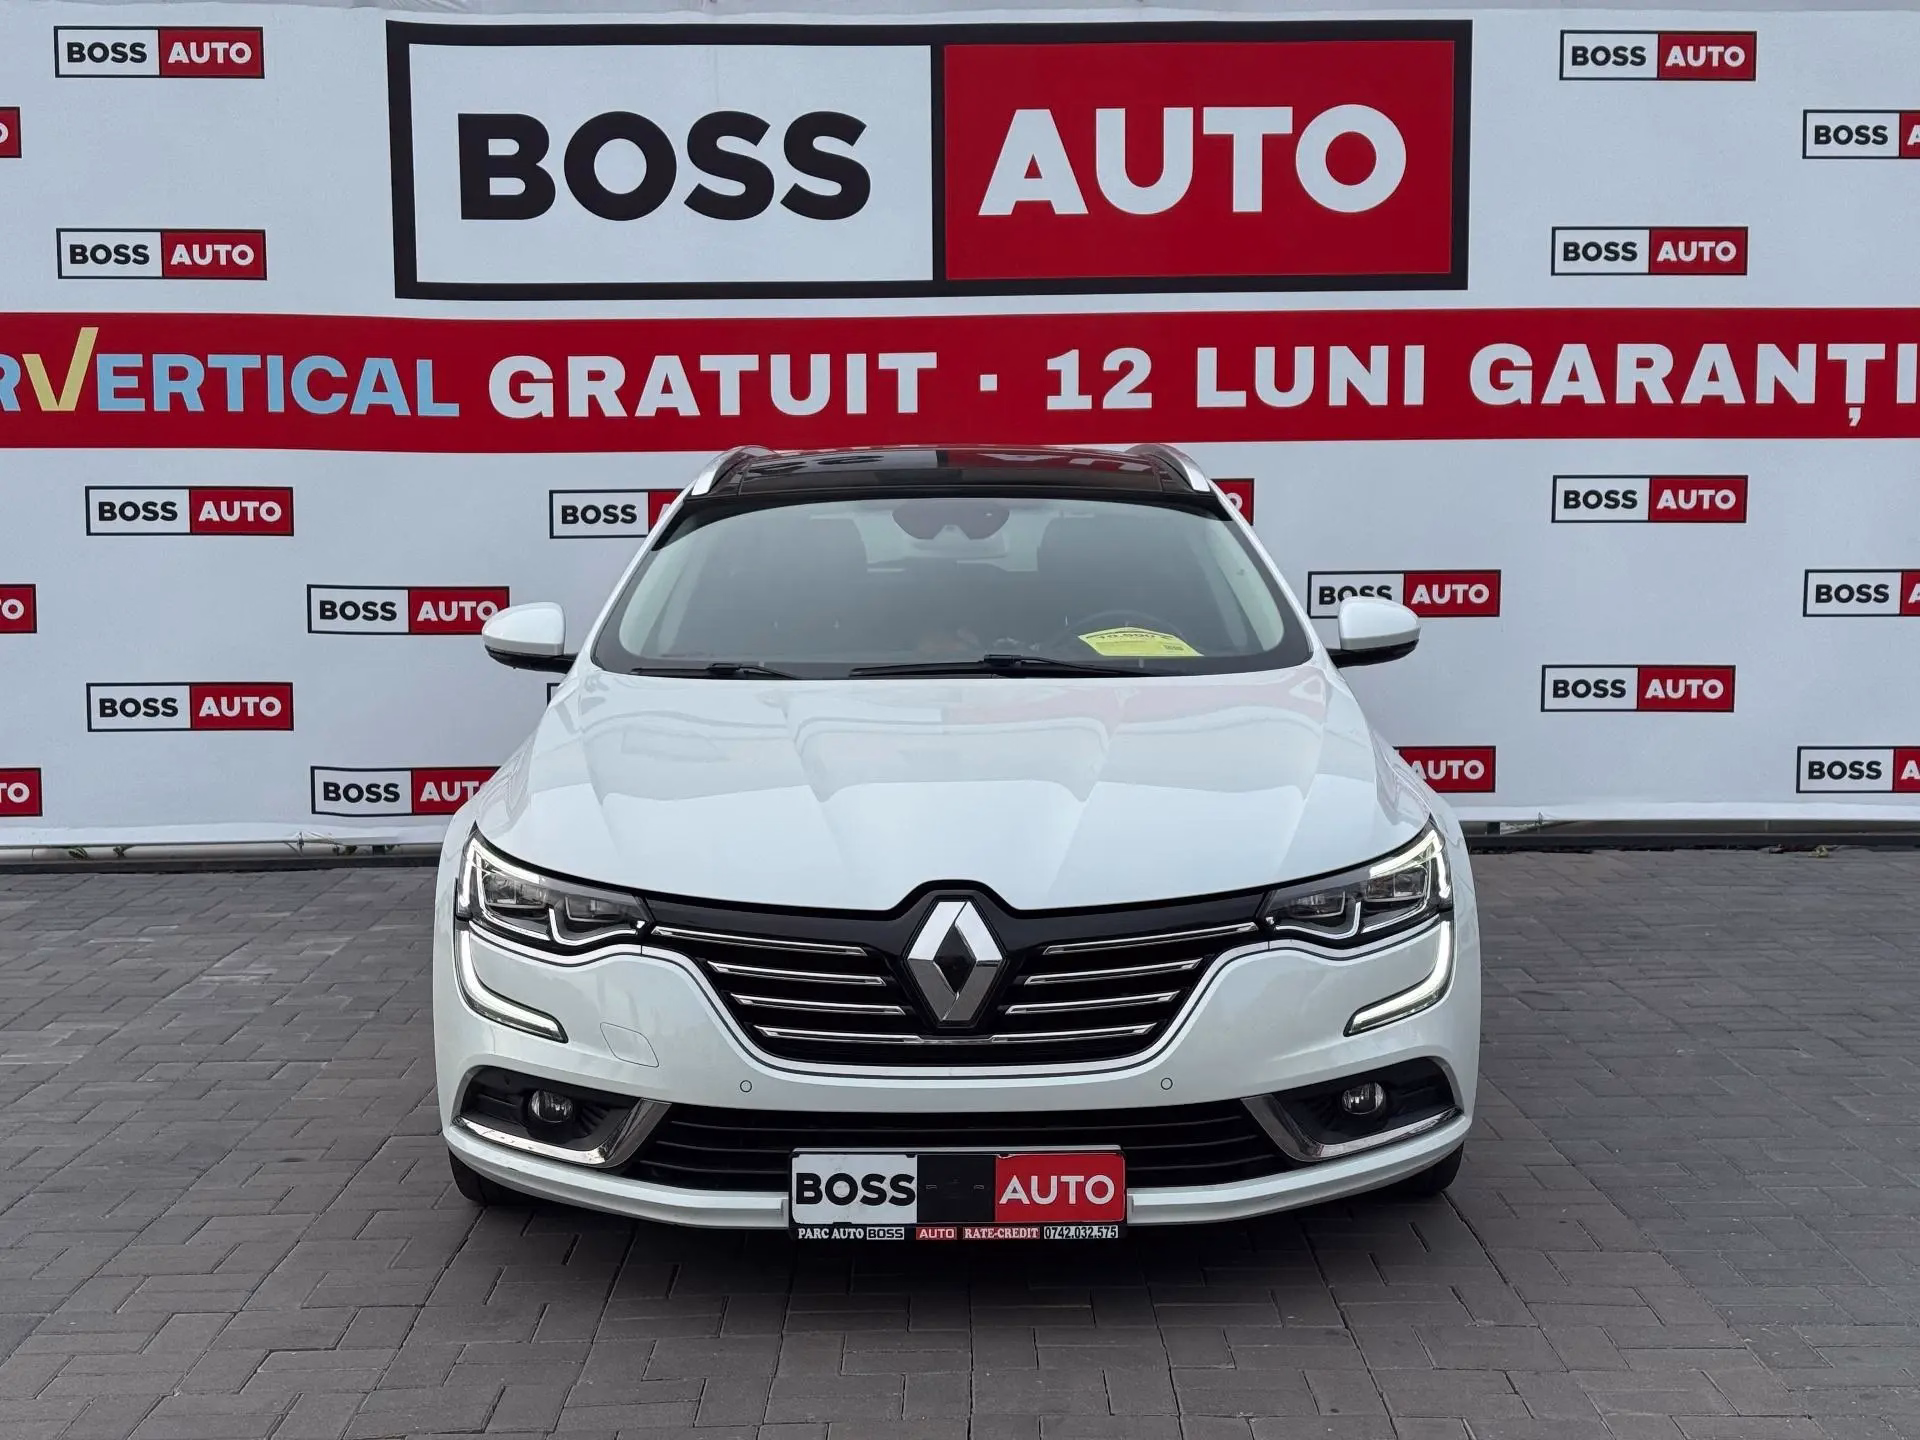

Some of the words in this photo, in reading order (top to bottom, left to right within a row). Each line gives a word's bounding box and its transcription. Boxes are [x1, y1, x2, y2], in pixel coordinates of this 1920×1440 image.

[66, 41, 148, 64] BOSS
[168, 41, 252, 64] AUTO
[1571, 45, 1647, 67] BOSS
[1665, 45, 1746, 67] AUTO
[1814, 124, 1889, 146] BOSS
[458, 111, 871, 221] BOSS
[979, 104, 1407, 215] AUTO
[69, 243, 150, 265] BOSS
[170, 243, 255, 266] AUTO
[1563, 241, 1638, 262] BOSS
[1656, 241, 1737, 262] AUTO
[488, 351, 938, 419] GRATUIT
[1046, 347, 1153, 411] 12
[1196, 344, 1425, 408] LUNI
[1563, 489, 1638, 510] BOSS
[1656, 489, 1737, 510] AUTO
[98, 501, 178, 522] BOSS
[198, 501, 282, 522] AUTO
[561, 504, 638, 525] BOSS
[1410, 584, 1490, 605] AUTO
[1815, 583, 1890, 604] BOSS
[319, 600, 398, 621] BOSS
[416, 600, 498, 622] AUTO
[1552, 678, 1627, 699] BOSS
[1645, 678, 1724, 699] AUTO
[99, 697, 179, 718] BOSS
[199, 696, 282, 718] AUTO
[1807, 760, 1883, 780] BOSS
[323, 781, 401, 804] BOSS
[420, 781, 488, 803] AUT
[795, 1172, 916, 1206] BOSS
[999, 1174, 1115, 1205] AUTO
[798, 1228, 830, 1240] PARC
[831, 1228, 865, 1240] AUTO
[867, 1227, 905, 1240] BOSS
[918, 1228, 956, 1240] AUTO
[964, 1227, 1039, 1239] RATE-CREDIT
[1044, 1226, 1118, 1239] 0742.032.575
